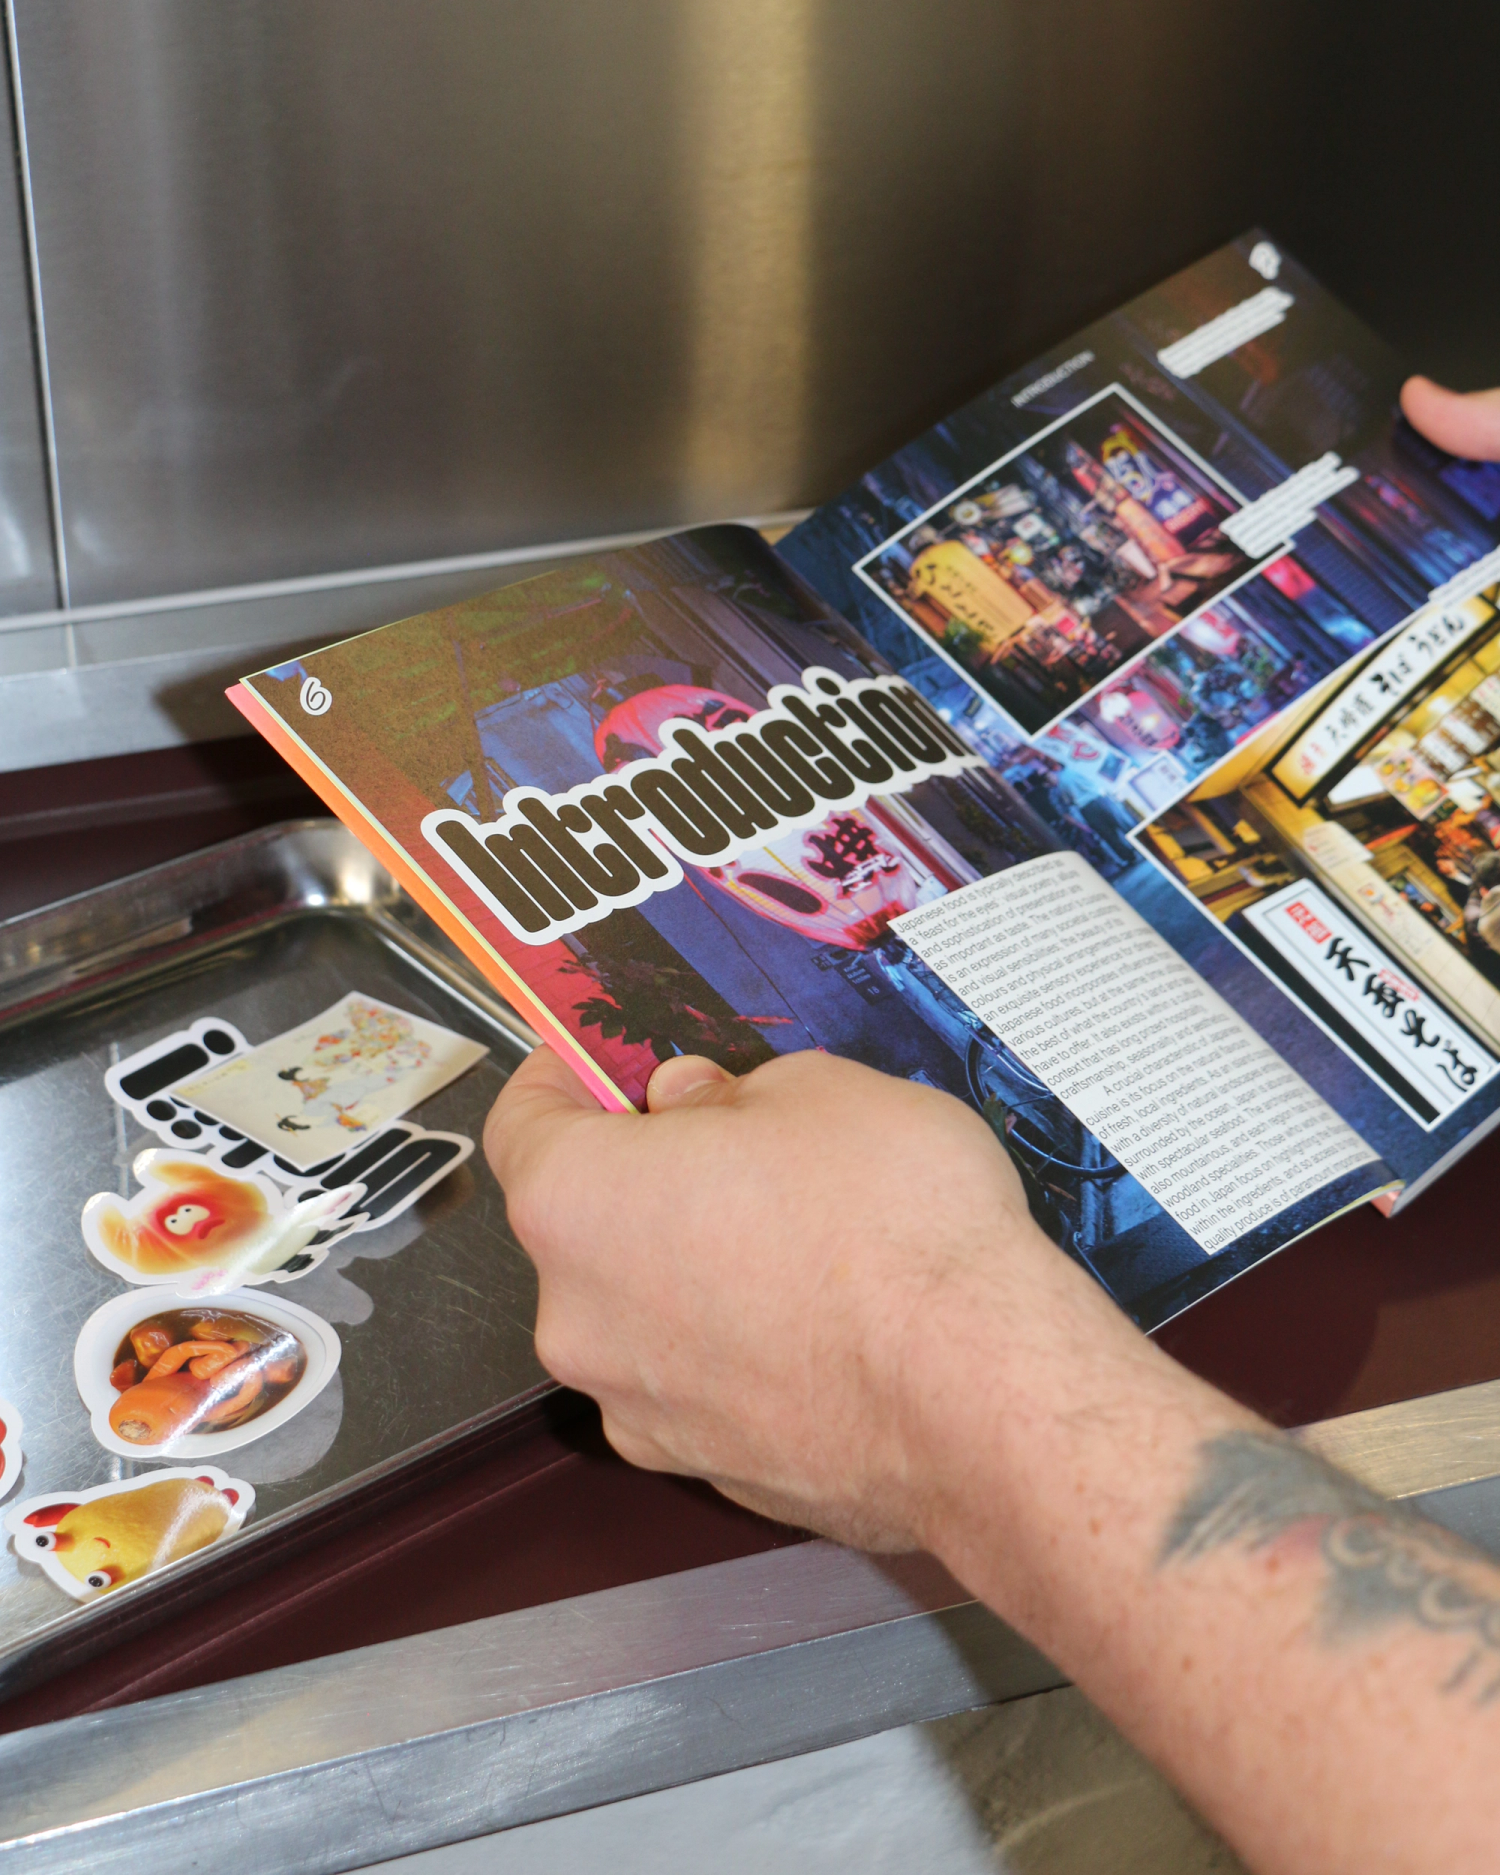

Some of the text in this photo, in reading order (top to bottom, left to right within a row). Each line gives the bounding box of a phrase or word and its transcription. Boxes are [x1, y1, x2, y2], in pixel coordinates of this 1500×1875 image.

[436, 677, 977, 933] Introduction
[897, 906, 945, 933] Japanese
[941, 895, 968, 911] food
[965, 892, 977, 901] is
[974, 877, 1014, 898] typically
[908, 937, 919, 946] a
[942, 917, 959, 928] for
[957, 910, 977, 922] the
[1002, 886, 1030, 902] visual
[920, 941, 943, 958] and
[941, 914, 1006, 948] sophistication
[1005, 906, 1017, 919] of
[933, 959, 948, 971] as
[944, 937, 994, 964] important
[992, 932, 1007, 942] as
[1003, 921, 1031, 936] taste.
[1027, 912, 1050, 924] The
[943, 973, 958, 983] is
[955, 967, 971, 978] an
[970, 943, 1021, 971] expression
[1020, 935, 1032, 947] of
[1030, 927, 1058, 942] many
[958, 979, 980, 996] and
[977, 966, 1008, 985] visual
[1006, 943, 1062, 972] sensibilities;
[1059, 935, 1078, 947] the
[970, 986, 1008, 1009] colours
[1006, 975, 1028, 991] and
[1025, 958, 1064, 983] physical
[983, 1010, 999, 1022] an
[997, 989, 1041, 1014] exquisite
[1039, 972, 1077, 993] sensory
[996, 1006, 1043, 1034] Japanese
[1039, 994, 1066, 1011] food
[1063, 971, 1119, 1000] incorporates
[1008, 1024, 1045, 1046] various
[1043, 1006, 1085, 1029] cultures,
[1081, 996, 1101, 1009] but
[1098, 991, 1111, 1002] at
[1106, 986, 1125, 997] the
[1019, 1047, 1040, 1060] the
[1035, 1034, 1062, 1051] best
[1059, 1027, 1071, 1040] of
[1069, 1017, 1095, 1034] what
[1091, 1011, 1110, 1023] the
[1031, 1056, 1060, 1073] have
[1056, 1050, 1070, 1060] to
[1068, 1038, 1094, 1055] offer.
[1090, 1032, 1103, 1042] It
[1100, 1024, 1122, 1038] also
[1119, 1011, 1147, 1028] exists
[1047, 1020, 1167, 1086] context that has long prized
[1060, 1060, 1128, 1099] craftsmanship,
[1126, 1036, 1177, 1063] seasonality
[1102, 1085, 1115, 1096] A
[1112, 1068, 1144, 1091] crucial
[1142, 1042, 1200, 1074] characteristic
[1085, 1103, 1121, 1126] cuisine
[1116, 1097, 1131, 1108] is
[1125, 1091, 1142, 1103] its
[1138, 1078, 1167, 1096] focus
[1165, 1071, 1180, 1082] on
[1176, 1064, 1194, 1076] the
[1098, 1125, 1111, 1140] of
[1107, 1115, 1139, 1133] fresh,
[1133, 1099, 1160, 1118] local
[1158, 1076, 1209, 1106] ingredients.
[1110, 1136, 1134, 1153] with
[1131, 1132, 1142, 1142] a
[1139, 1112, 1179, 1137] diversity
[1176, 1103, 1189, 1116] of
[1187, 1088, 1218, 1110] natural
[1124, 1131, 1178, 1167] surrounded
[1174, 1125, 1192, 1137] by
[1187, 1117, 1206, 1130] the
[1203, 1102, 1235, 1121] ocean,
[1136, 1163, 1160, 1180] with
[1157, 1134, 1209, 1168] spectacular
[1209, 1115, 1247, 1139] seafood.
[1150, 1177, 1173, 1194] also
[1170, 1144, 1232, 1182] mountainous,
[1229, 1131, 1250, 1148] and
[1163, 1175, 1210, 1207] woodland
[1208, 1149, 1259, 1181] specialities.
[1174, 1201, 1201, 1221] food
[1195, 1198, 1211, 1209] in
[1208, 1181, 1239, 1202] Japan
[1234, 1166, 1263, 1185] focus
[1260, 1159, 1275, 1171] on
[1189, 1214, 1220, 1235] within
[1216, 1204, 1236, 1218] the
[1231, 1176, 1285, 1208] ingredients,
[1283, 1163, 1302, 1179] and
[1203, 1226, 1237, 1250] quality
[1234, 1203, 1273, 1232] produce
[1268, 1197, 1282, 1208] is
[1279, 1189, 1291, 1202] of
